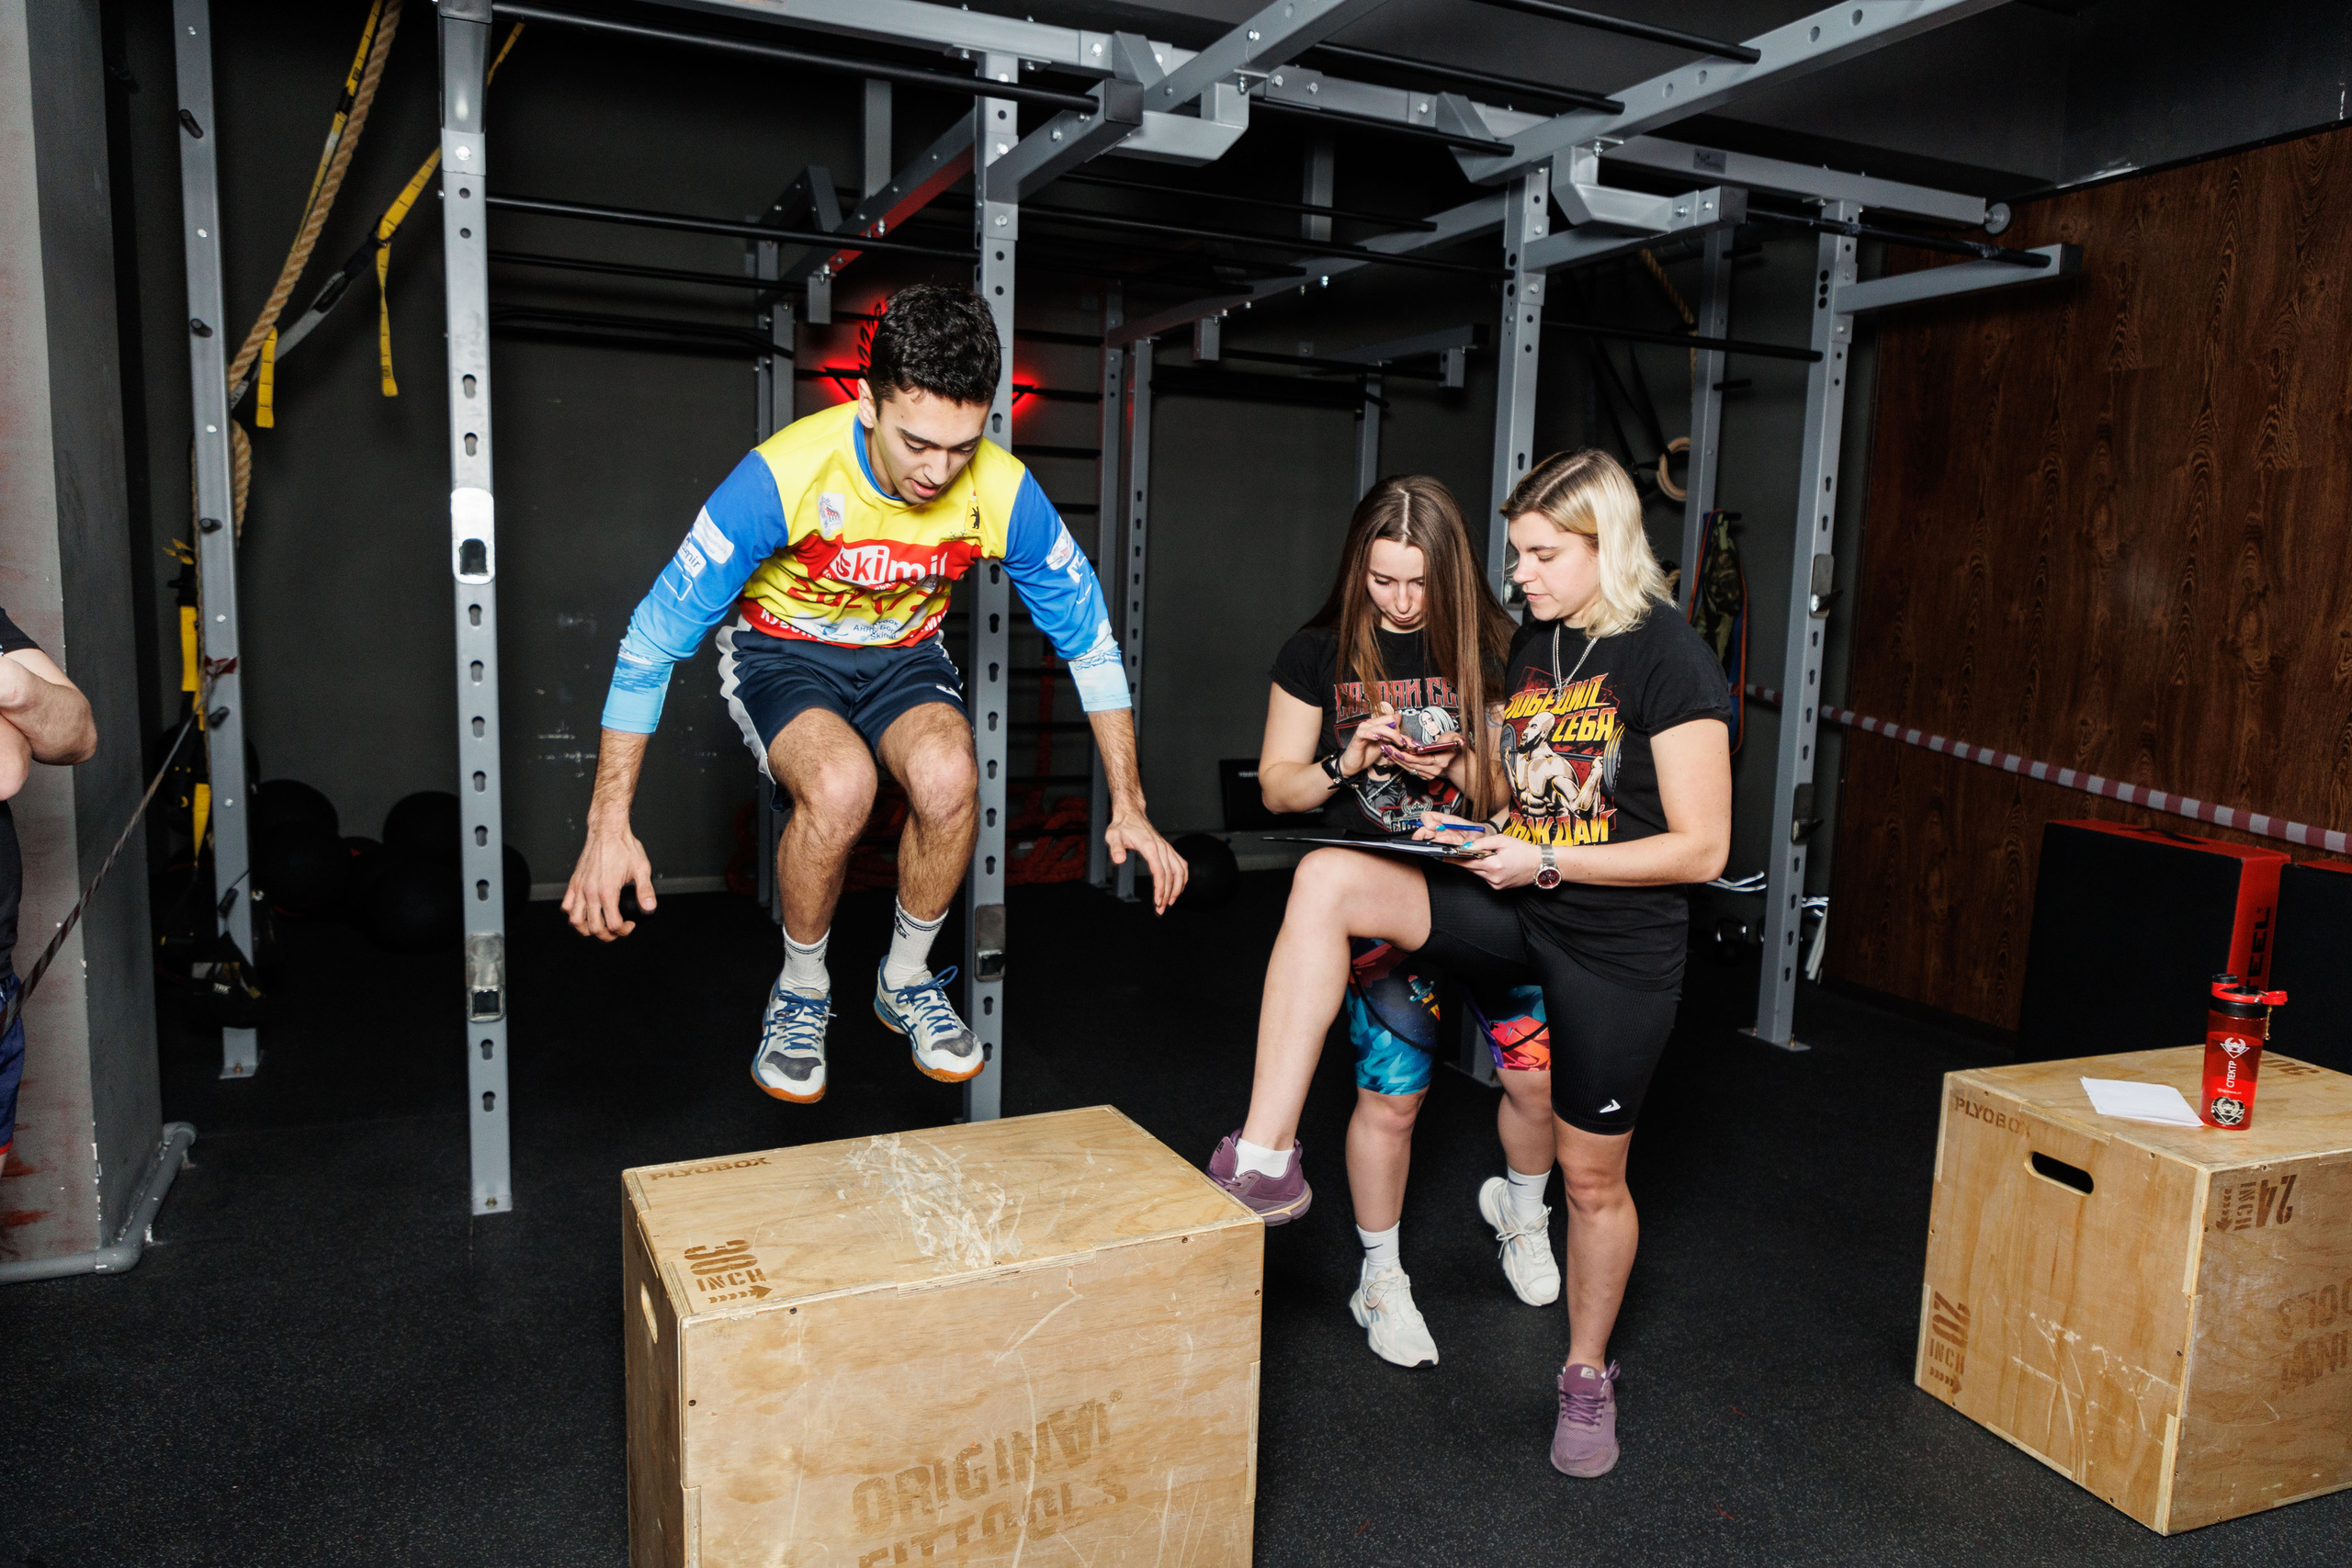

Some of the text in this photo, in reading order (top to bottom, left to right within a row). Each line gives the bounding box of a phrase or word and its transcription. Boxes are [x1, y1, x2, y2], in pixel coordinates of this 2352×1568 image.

[1551, 706, 1618, 742] СЕБЯ
[1953, 1096, 2031, 1137] PLYOBOX
[649, 1156, 773, 1181] PLYOBOX
[2233, 1181, 2257, 1231] INCH
[2256, 1174, 2298, 1228] 24
[684, 1239, 759, 1276] 30
[695, 1268, 768, 1292] INCH
[1932, 1290, 1971, 1348] 20
[1929, 1337, 1965, 1376] INCH
